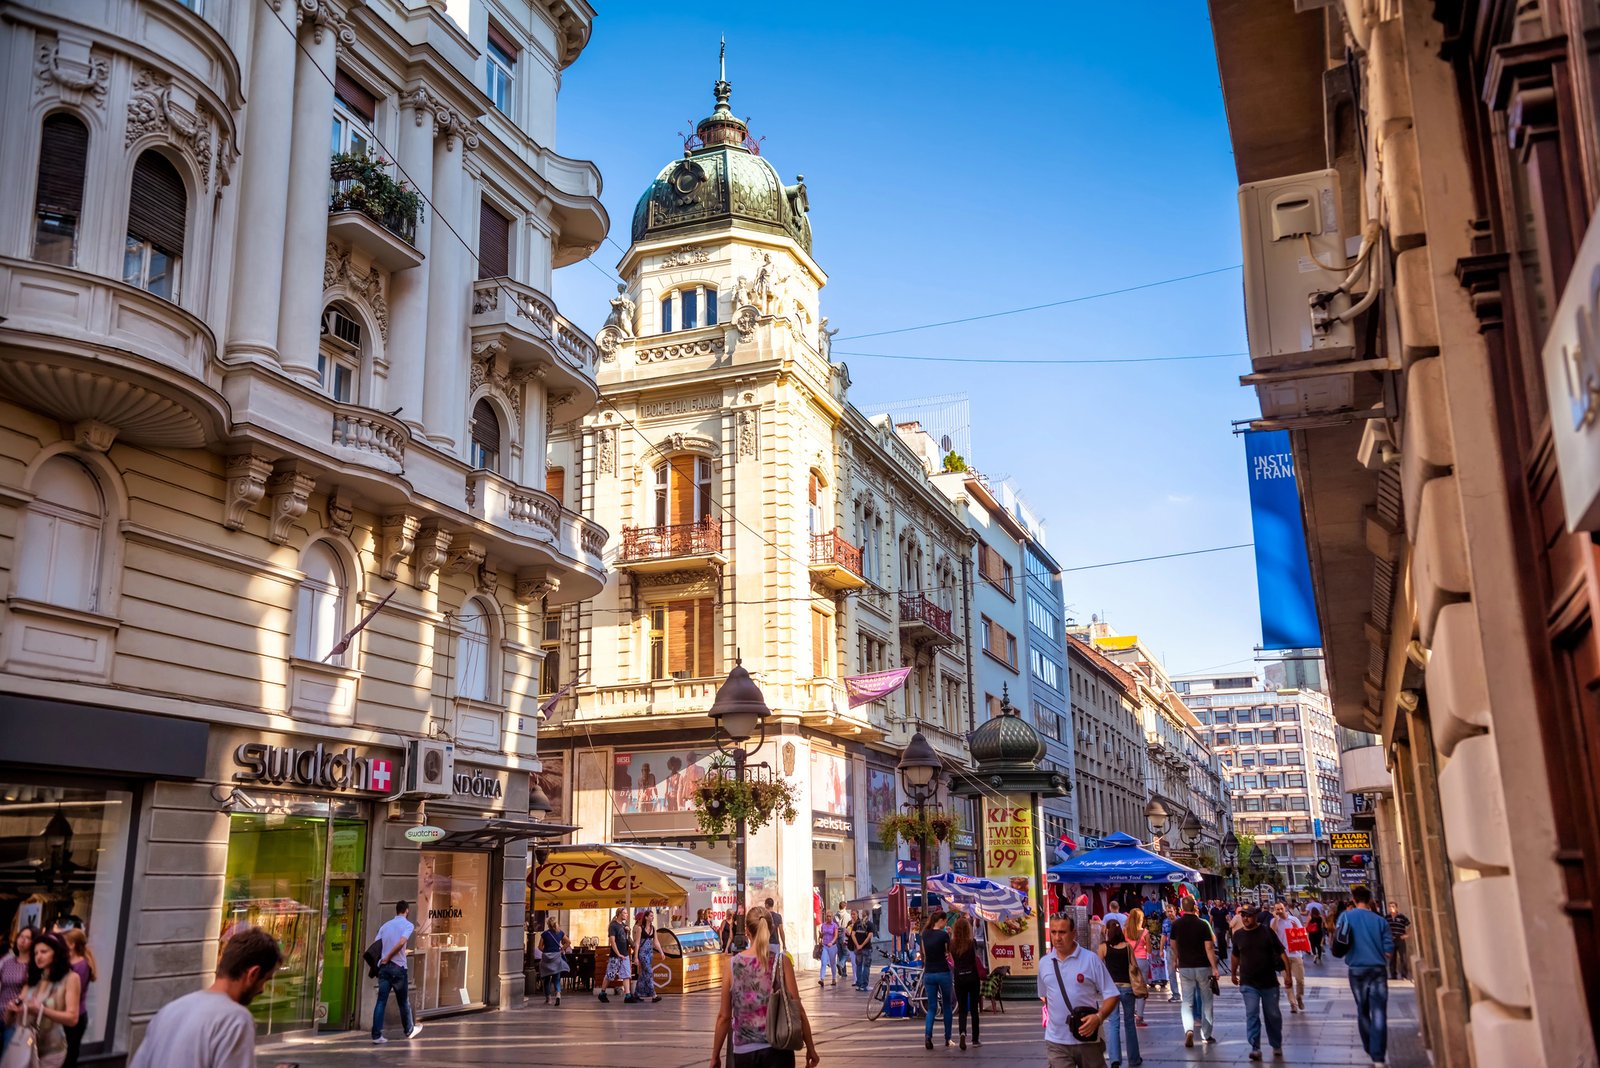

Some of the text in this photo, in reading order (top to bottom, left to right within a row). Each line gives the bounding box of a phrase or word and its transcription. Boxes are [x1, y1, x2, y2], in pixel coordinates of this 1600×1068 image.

[640, 394, 722, 418] ПРОМЕТНА БАНКА
[232, 743, 368, 790] swatch
[453, 769, 502, 799] NDORA
[987, 808, 1027, 823] KFC
[408, 830, 432, 838] swatch
[988, 826, 1030, 838] TWIST
[987, 849, 1018, 868] 199
[526, 861, 642, 893] Cola
[429, 907, 463, 918] PANDORA
